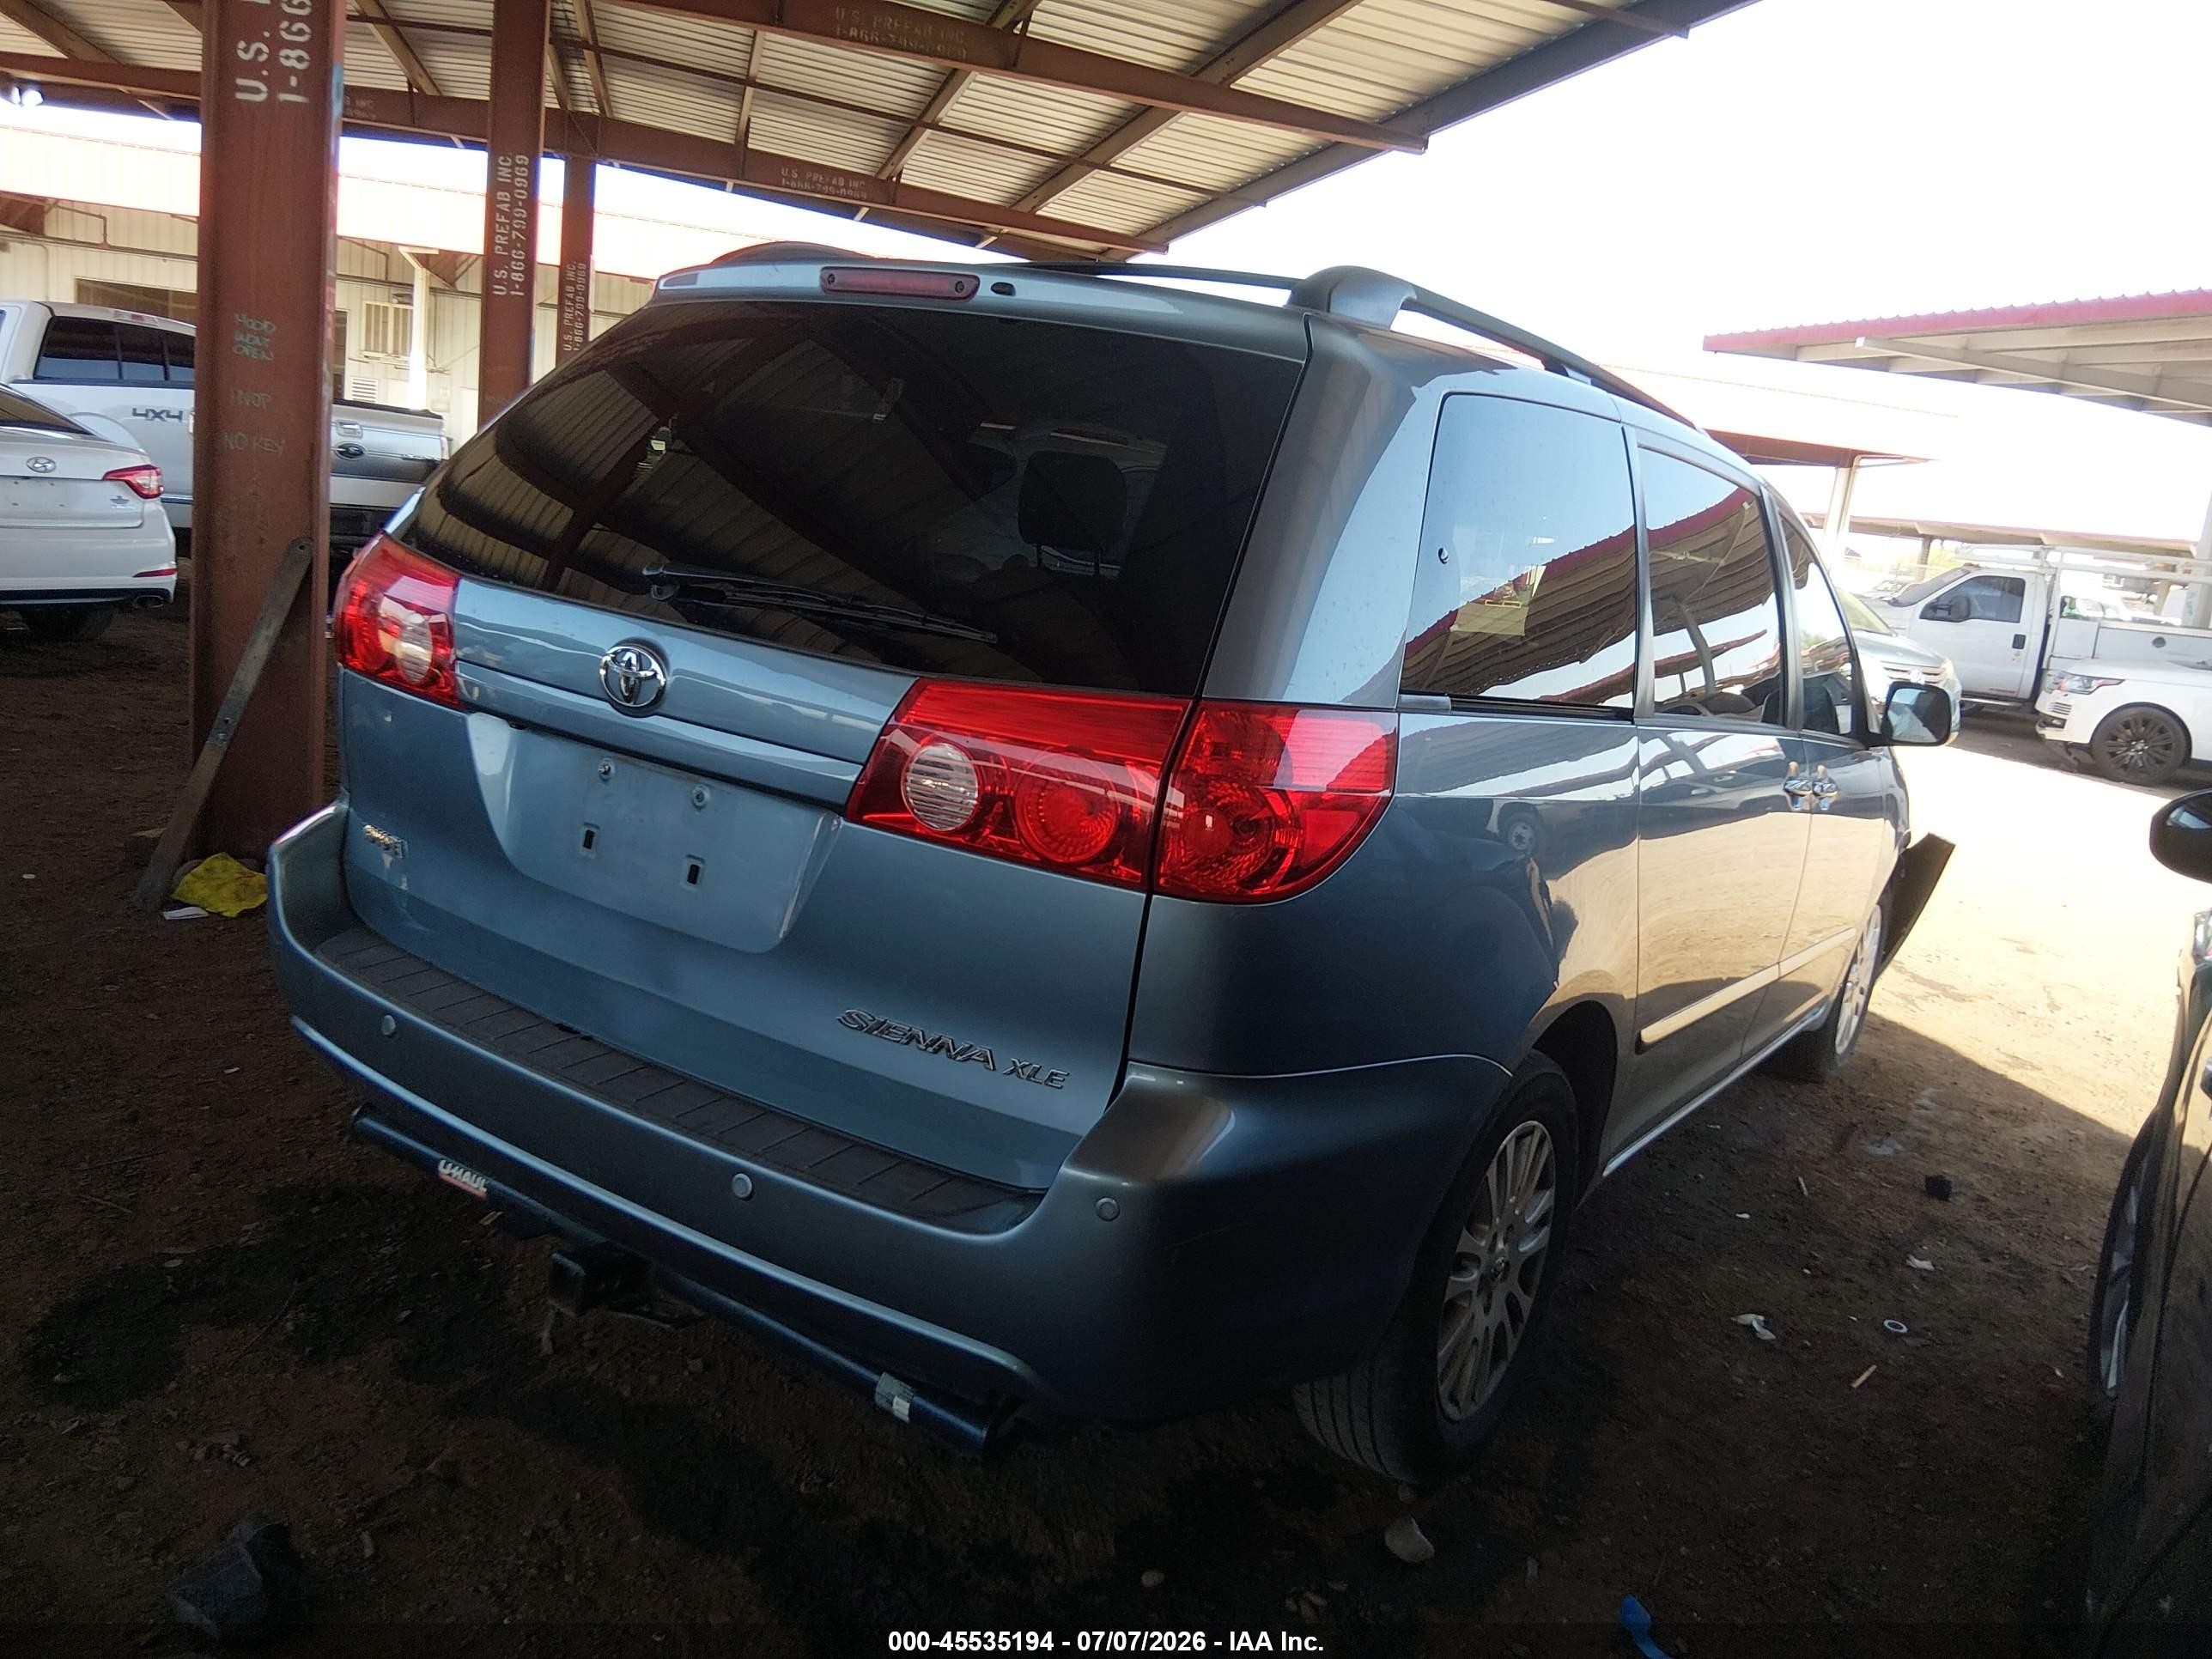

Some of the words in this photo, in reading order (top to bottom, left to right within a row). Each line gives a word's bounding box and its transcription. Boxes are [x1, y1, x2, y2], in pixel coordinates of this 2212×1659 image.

[235, 31, 270, 102] U.S.
[805, 171, 845, 186] PREAB
[494, 191, 511, 256] PREFAB
[510, 154, 530, 296] 1-866-799-0969
[836, 1009, 996, 1071] SIENNA
[1003, 1058, 1070, 1089] XLE
